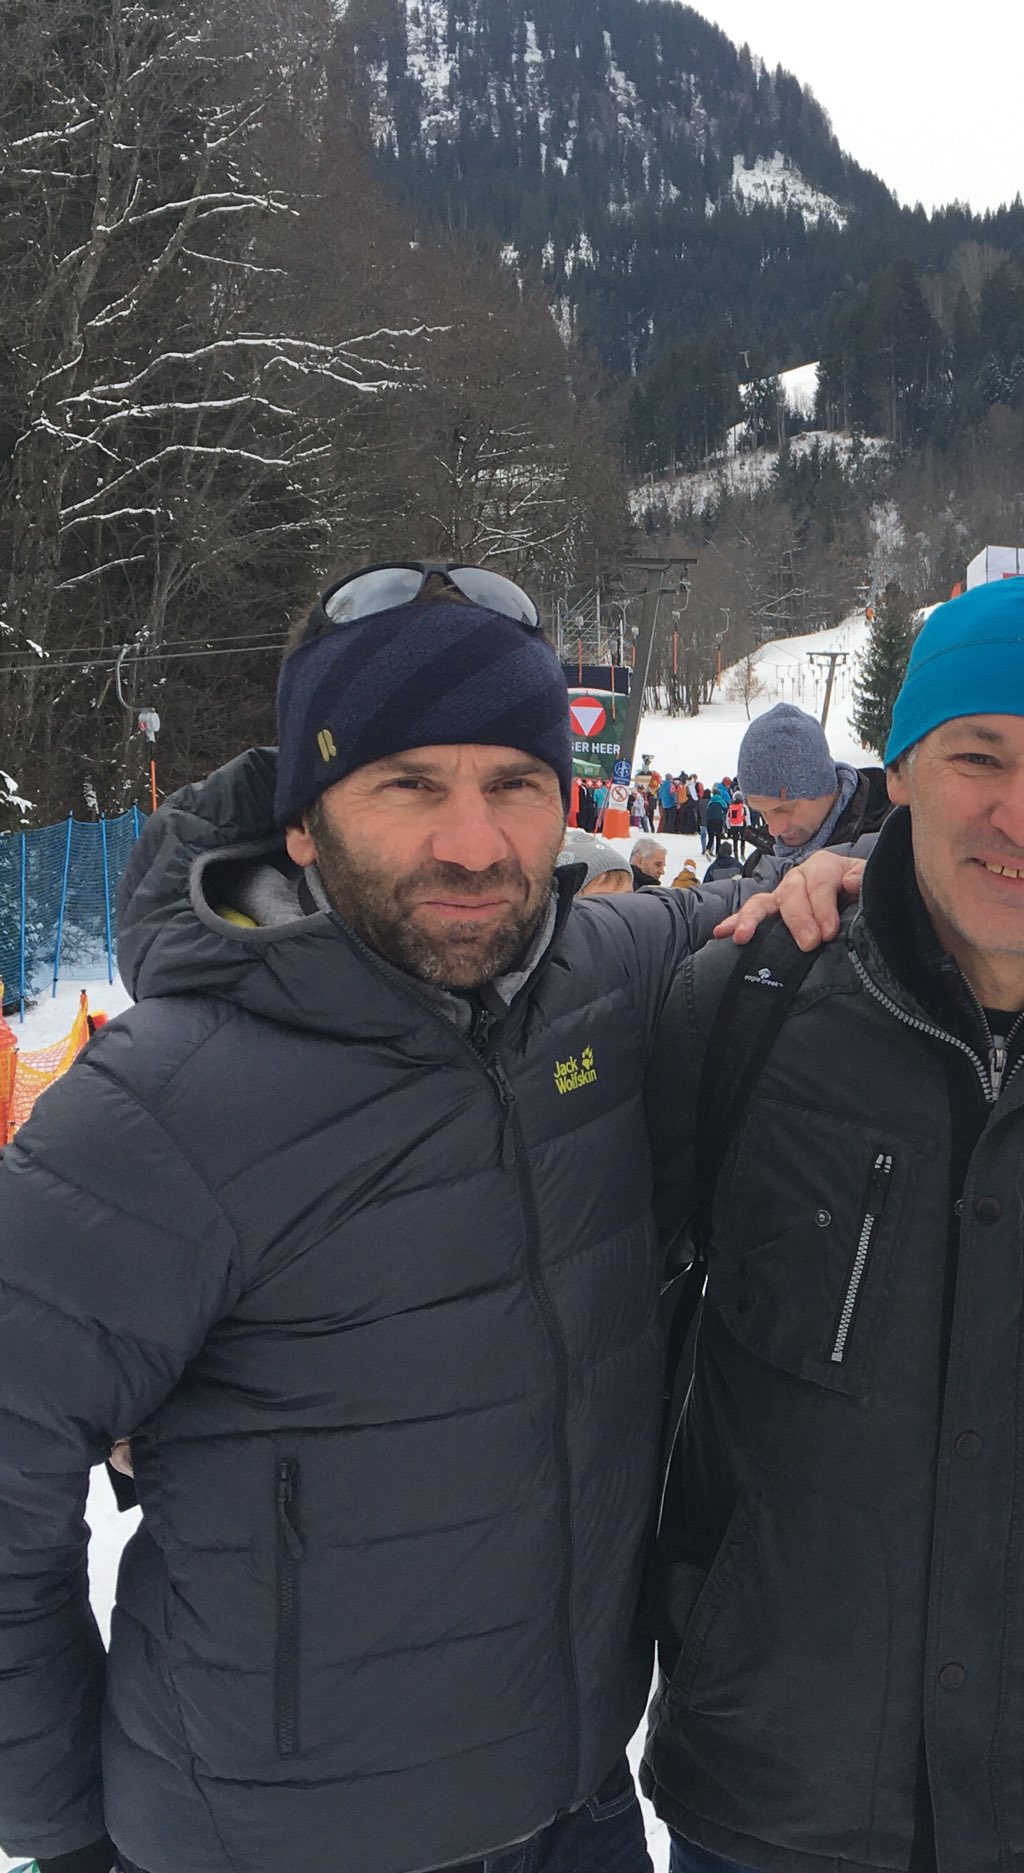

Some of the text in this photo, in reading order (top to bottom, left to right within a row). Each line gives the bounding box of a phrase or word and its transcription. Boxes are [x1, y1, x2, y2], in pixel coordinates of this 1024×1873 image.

[592, 742, 621, 755] HEER
[553, 1056, 578, 1078] Jack
[555, 1069, 597, 1094] Wolfskin
